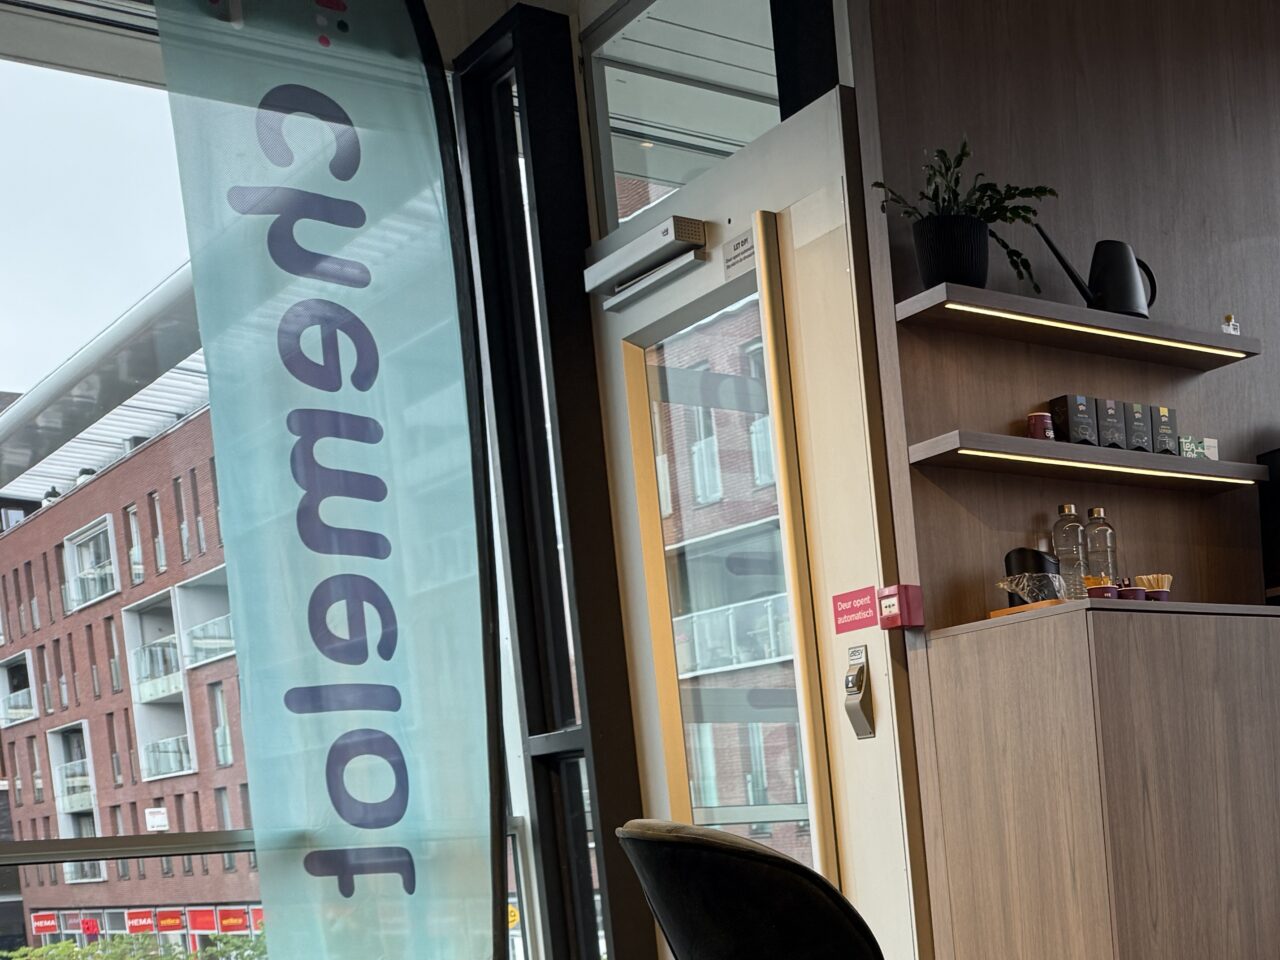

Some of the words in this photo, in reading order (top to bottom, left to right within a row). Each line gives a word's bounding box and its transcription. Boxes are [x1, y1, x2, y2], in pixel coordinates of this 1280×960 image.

[837, 600, 852, 611] Deur
[852, 596, 871, 608] opent
[837, 608, 874, 625] automatisch
[128, 918, 152, 927] HEMA
